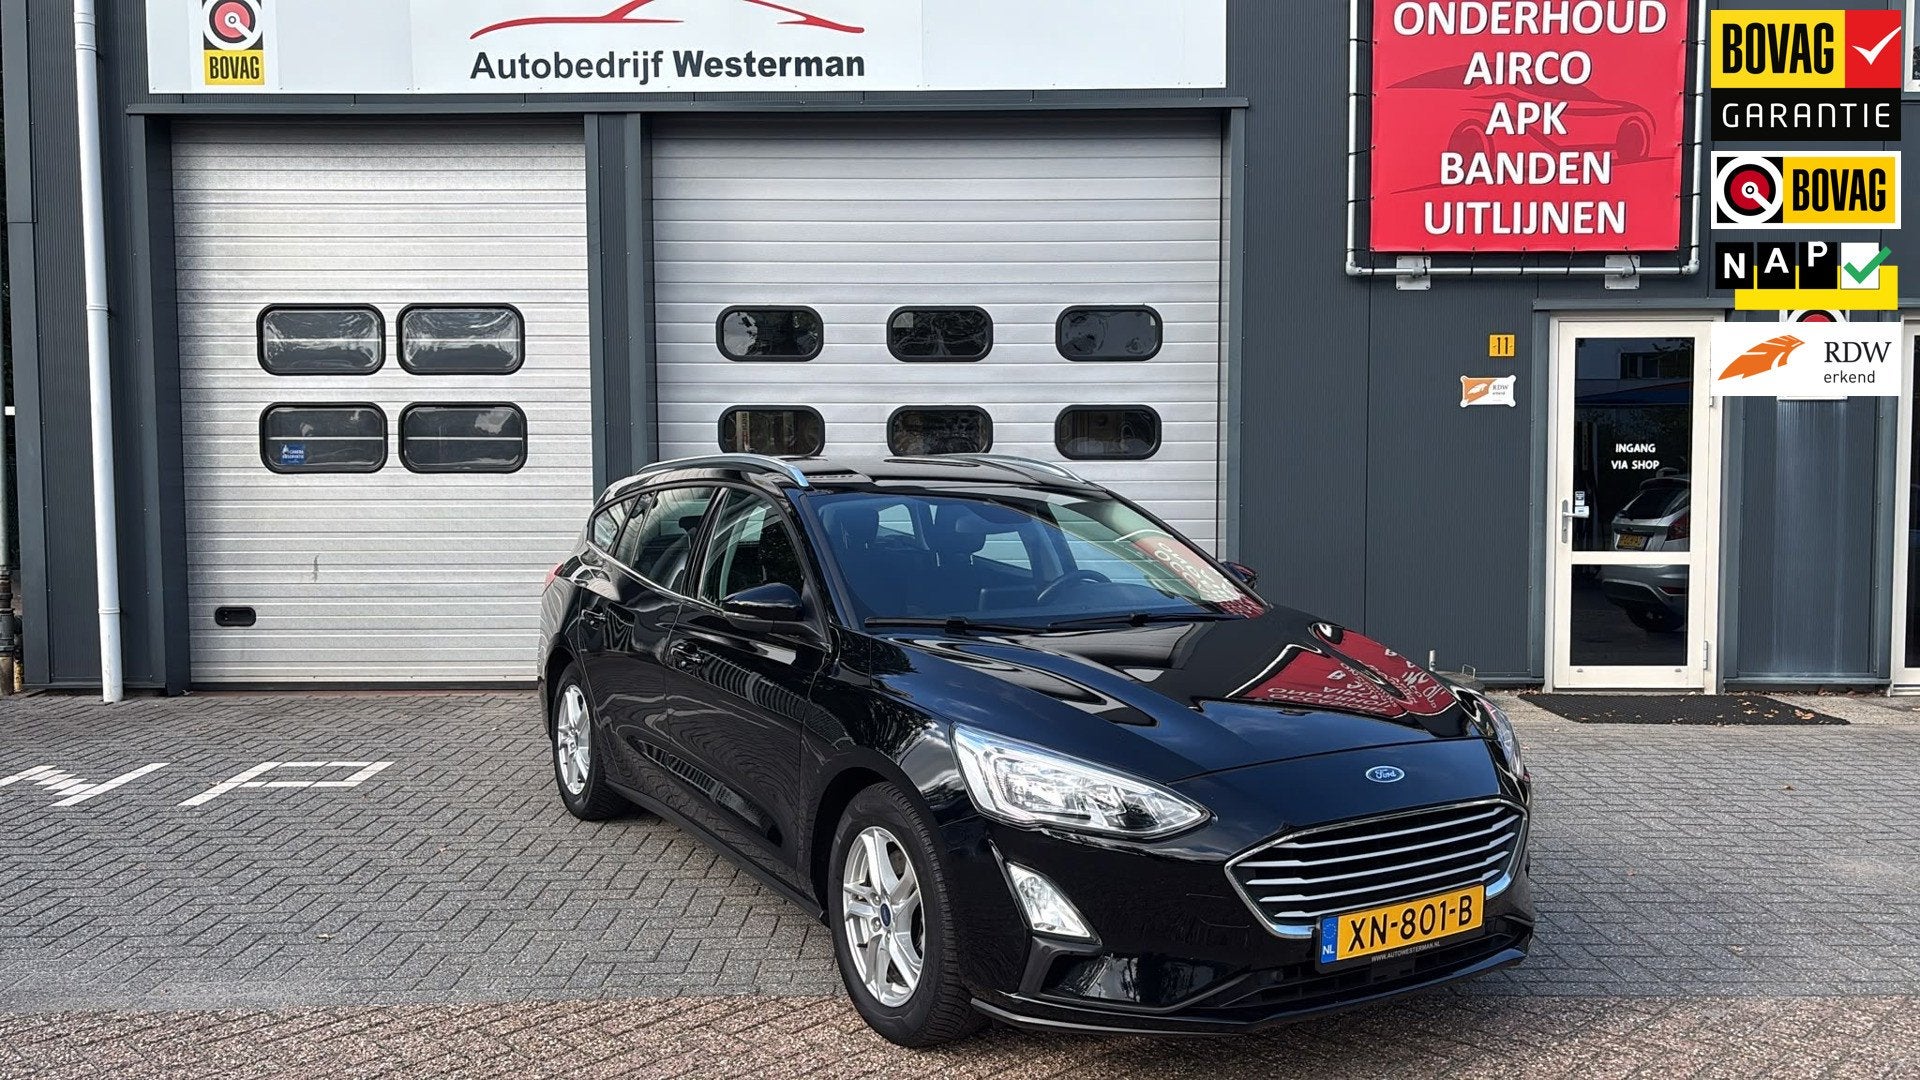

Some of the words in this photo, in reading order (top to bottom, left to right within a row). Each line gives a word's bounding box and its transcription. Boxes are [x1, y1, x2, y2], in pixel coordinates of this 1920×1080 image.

[1393, 0, 1668, 36] ONDERHOUD
[209, 55, 260, 80] BOVAG
[470, 51, 664, 85] Autobedrijf
[673, 50, 865, 77] Westerman
[1463, 50, 1593, 86] AIRCO
[1485, 101, 1569, 136] APK
[1440, 151, 1612, 186] BANDEN
[1423, 201, 1626, 235] UITLIJNEN
[1497, 336, 1508, 355] 11
[1615, 443, 1656, 453] INGANG
[1611, 460, 1628, 470] VIA
[1631, 460, 1660, 470] SHOP
[1375, 769, 1397, 779] Ford
[1348, 895, 1472, 952] XN-801-B
[1322, 944, 1335, 955] NL
[1371, 941, 1441, 962] WWW.AUTOWESTERMAN.NL
